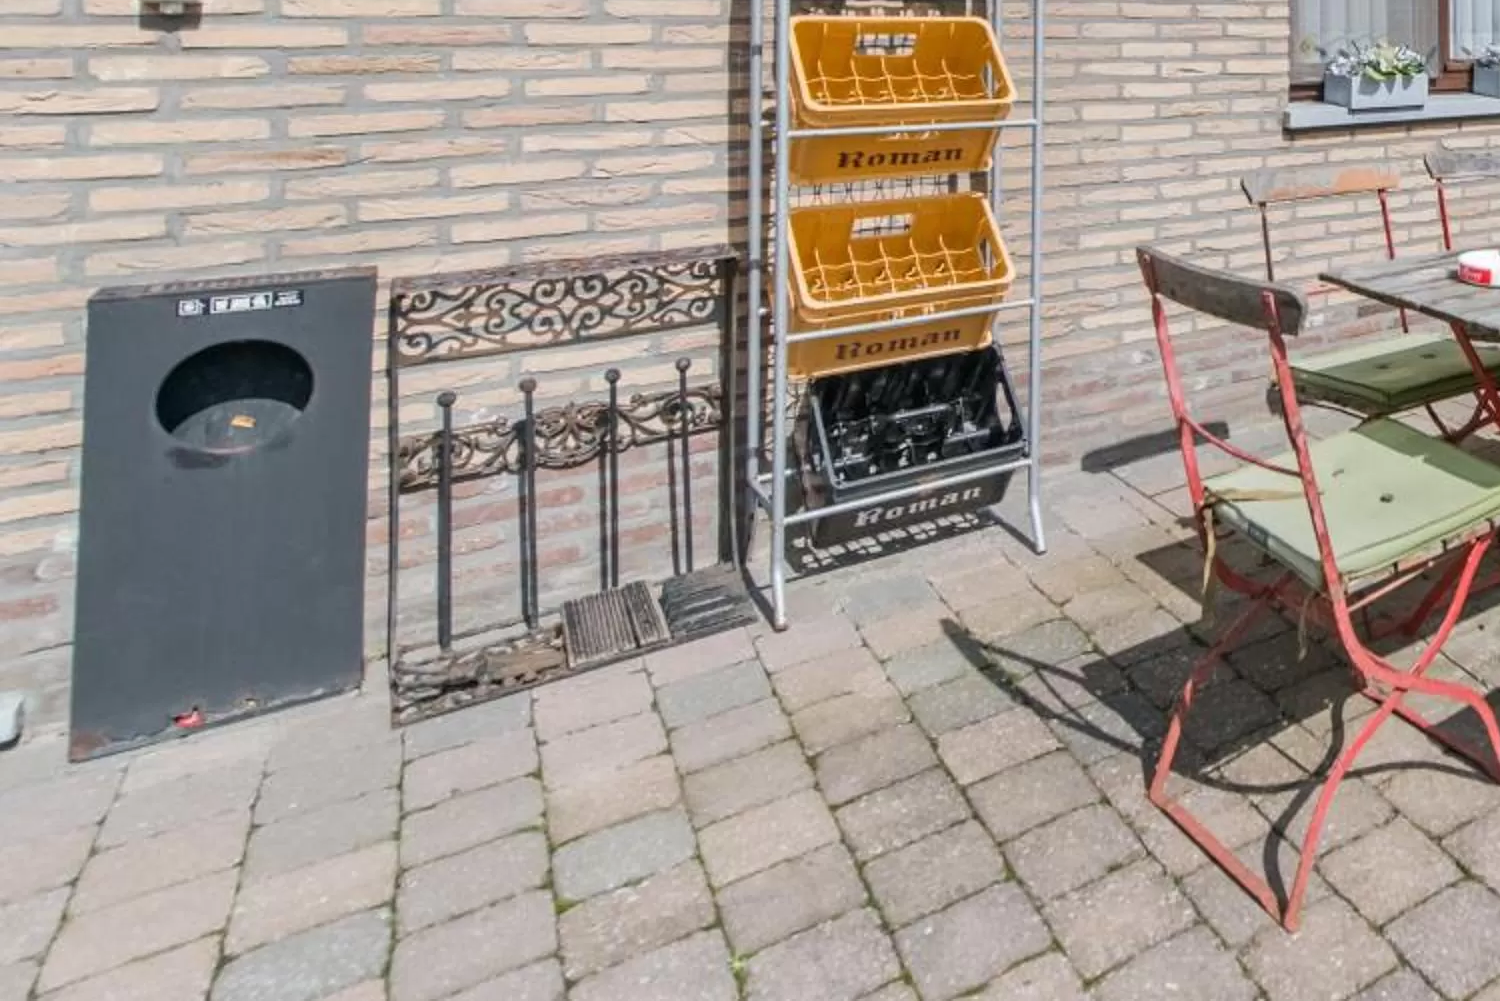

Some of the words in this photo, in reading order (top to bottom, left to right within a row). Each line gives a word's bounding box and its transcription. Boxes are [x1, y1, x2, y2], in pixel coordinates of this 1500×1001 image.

[837, 148, 963, 169] Roman
[835, 328, 961, 361] Roman
[853, 486, 983, 527] Roman
